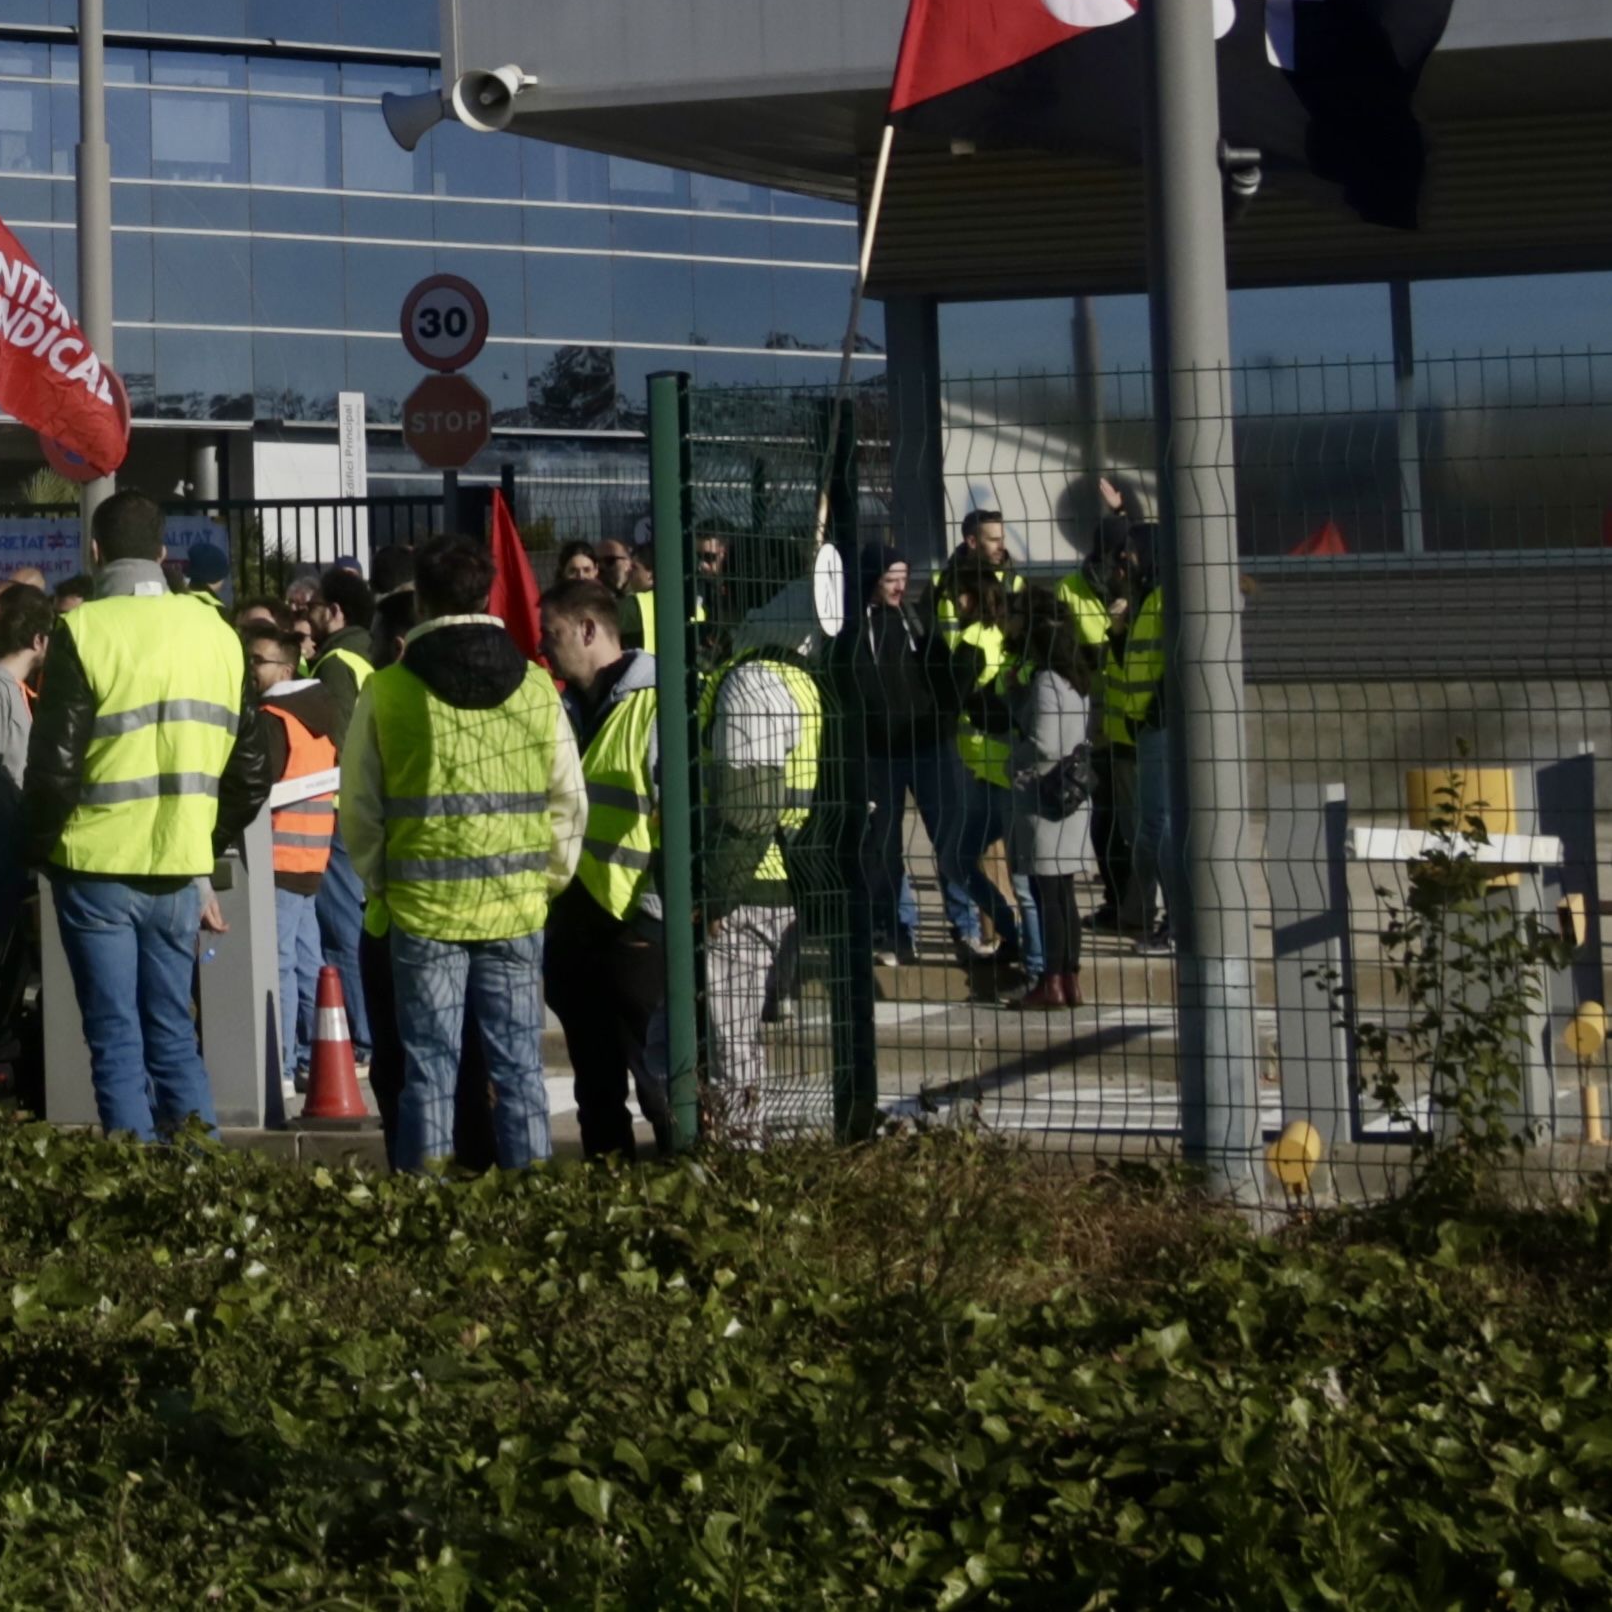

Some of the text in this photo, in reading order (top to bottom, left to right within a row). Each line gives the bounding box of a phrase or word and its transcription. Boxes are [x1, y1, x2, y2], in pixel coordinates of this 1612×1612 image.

[418, 307, 467, 338] 30
[343, 404, 355, 457] Principal
[411, 411, 482, 433] STOP
